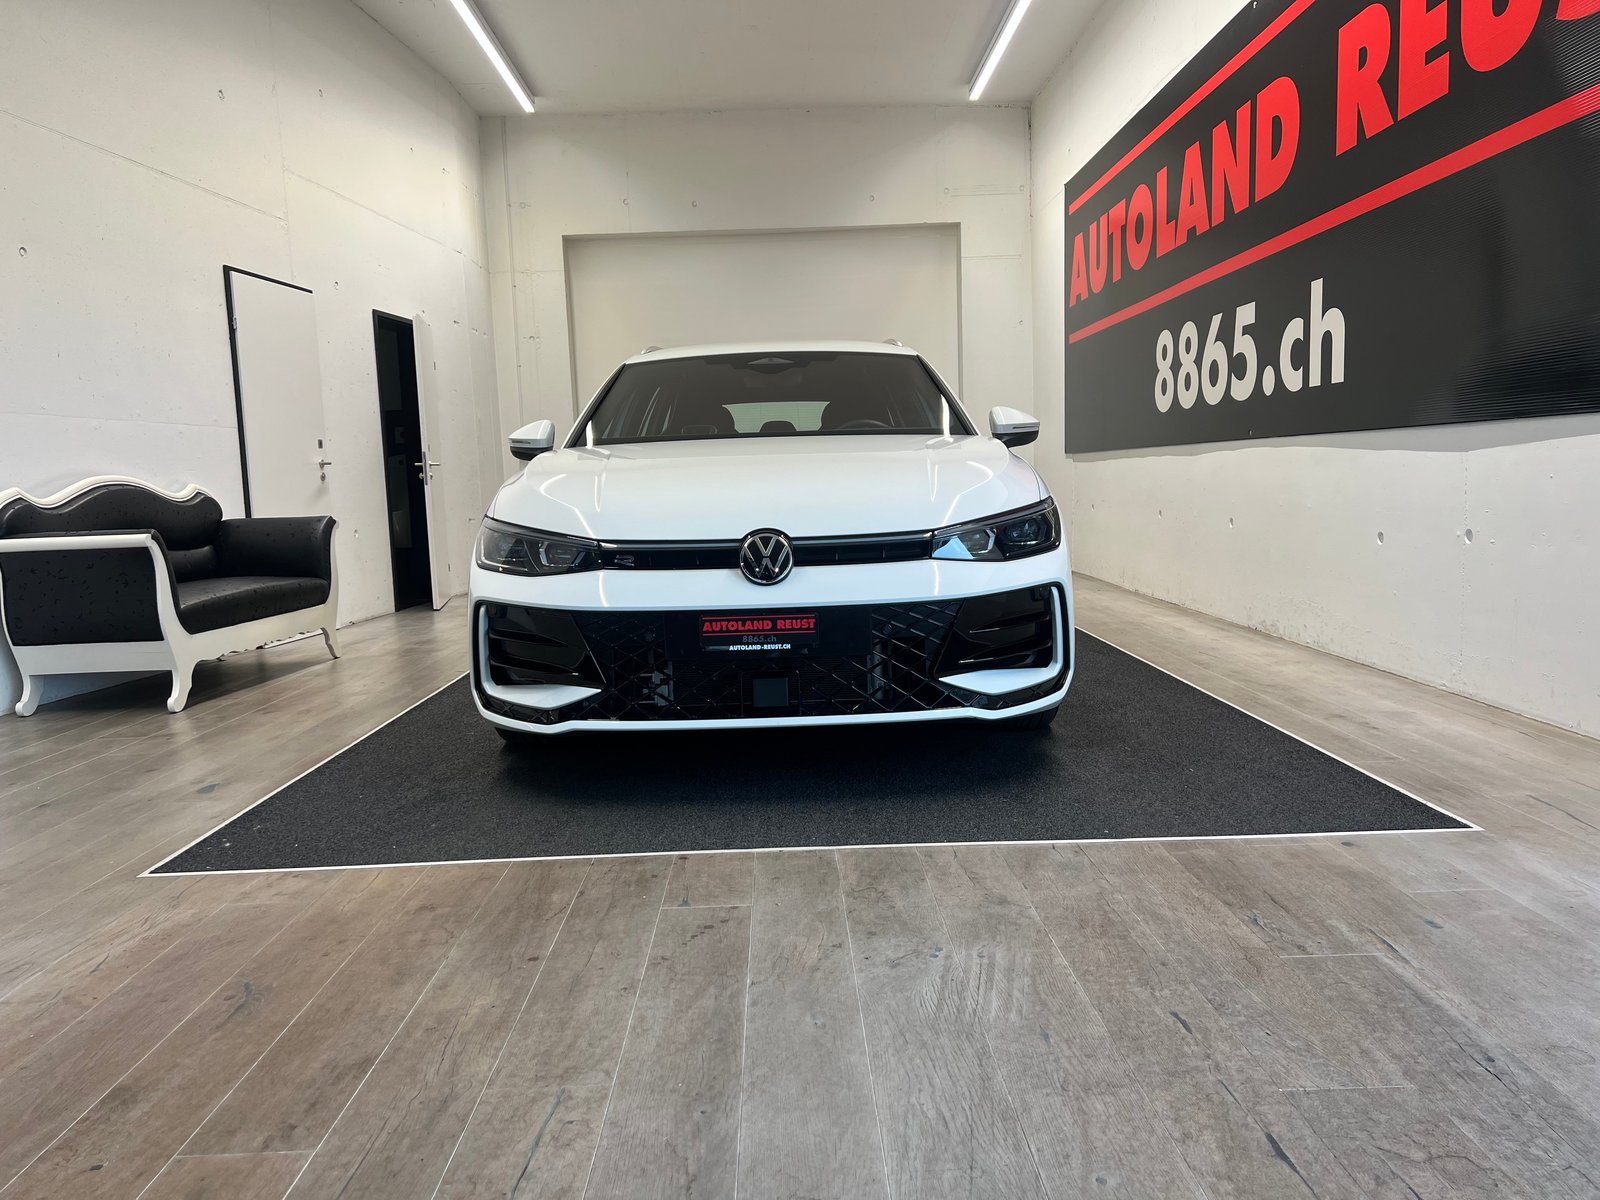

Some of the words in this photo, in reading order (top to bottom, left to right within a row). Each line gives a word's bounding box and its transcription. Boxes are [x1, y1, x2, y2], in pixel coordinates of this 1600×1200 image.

[1069, 76, 1301, 308] AUTOLAND
[1336, 0, 1600, 157] RE
[1154, 277, 1346, 413] 8865.ch
[702, 620, 772, 632] AUTOLAND
[776, 618, 816, 629] REUST
[742, 635, 777, 643] 8865.ch
[729, 643, 791, 651] AUTOLAND-REUST.CH
